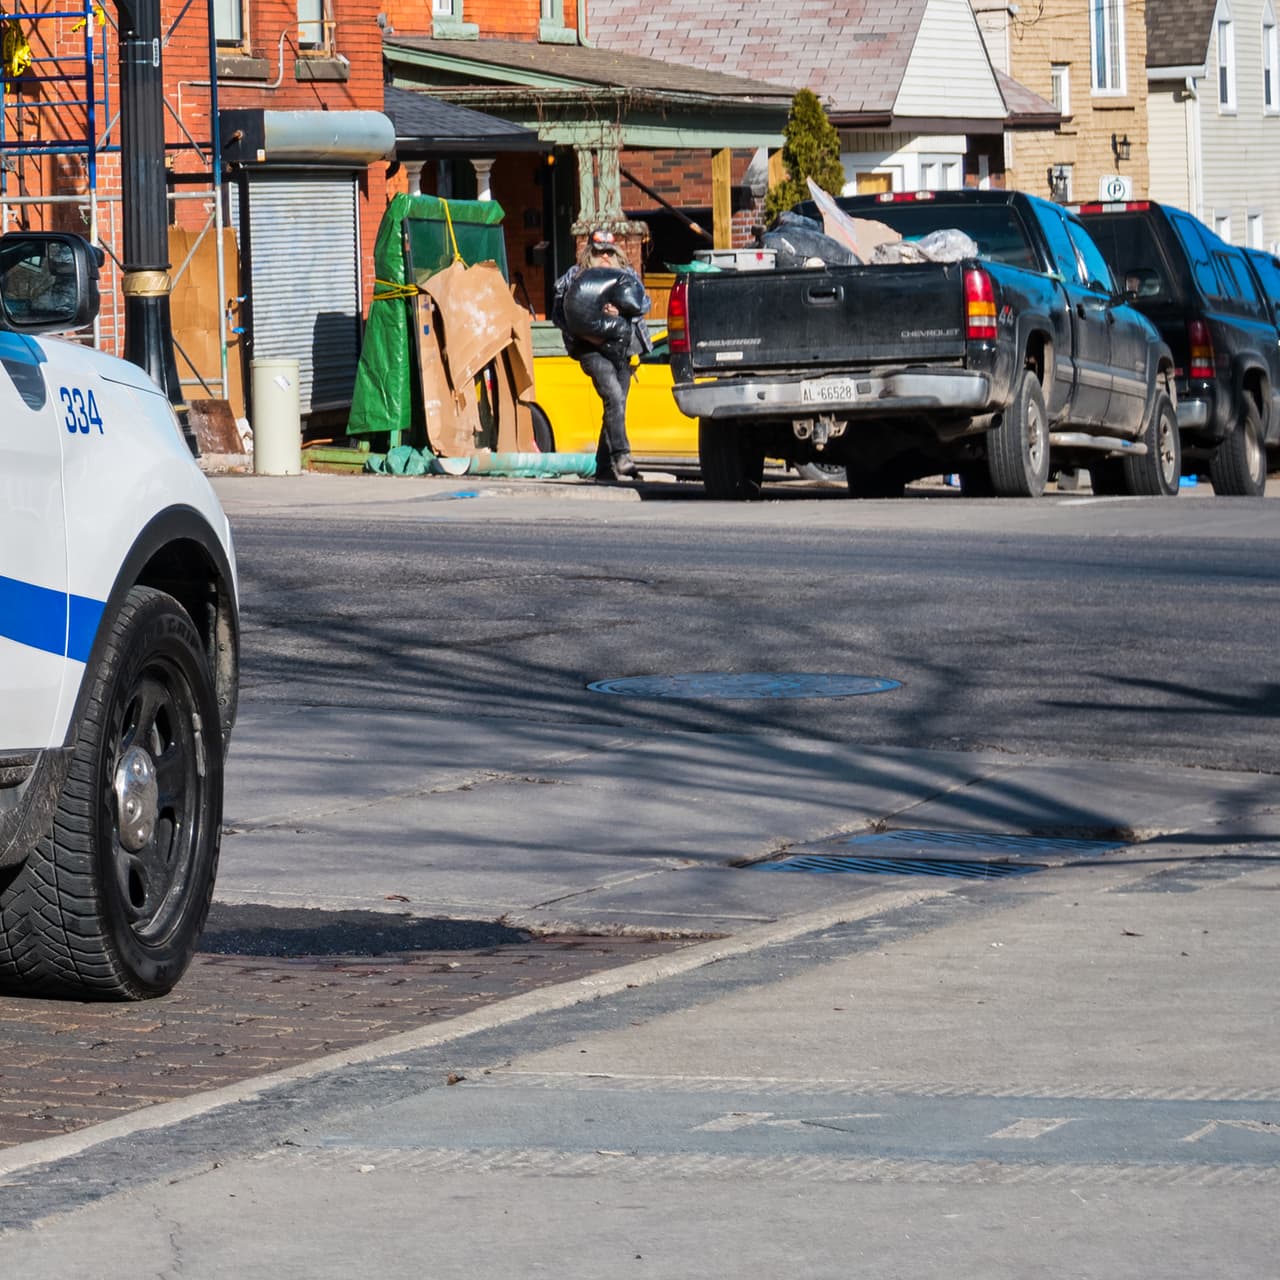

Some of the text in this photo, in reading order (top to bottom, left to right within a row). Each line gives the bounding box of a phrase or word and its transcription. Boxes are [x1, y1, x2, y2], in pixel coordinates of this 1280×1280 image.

[900, 327, 961, 338] CHEVROLET
[803, 384, 852, 401] AL 66528
[58, 385, 104, 435] 334
